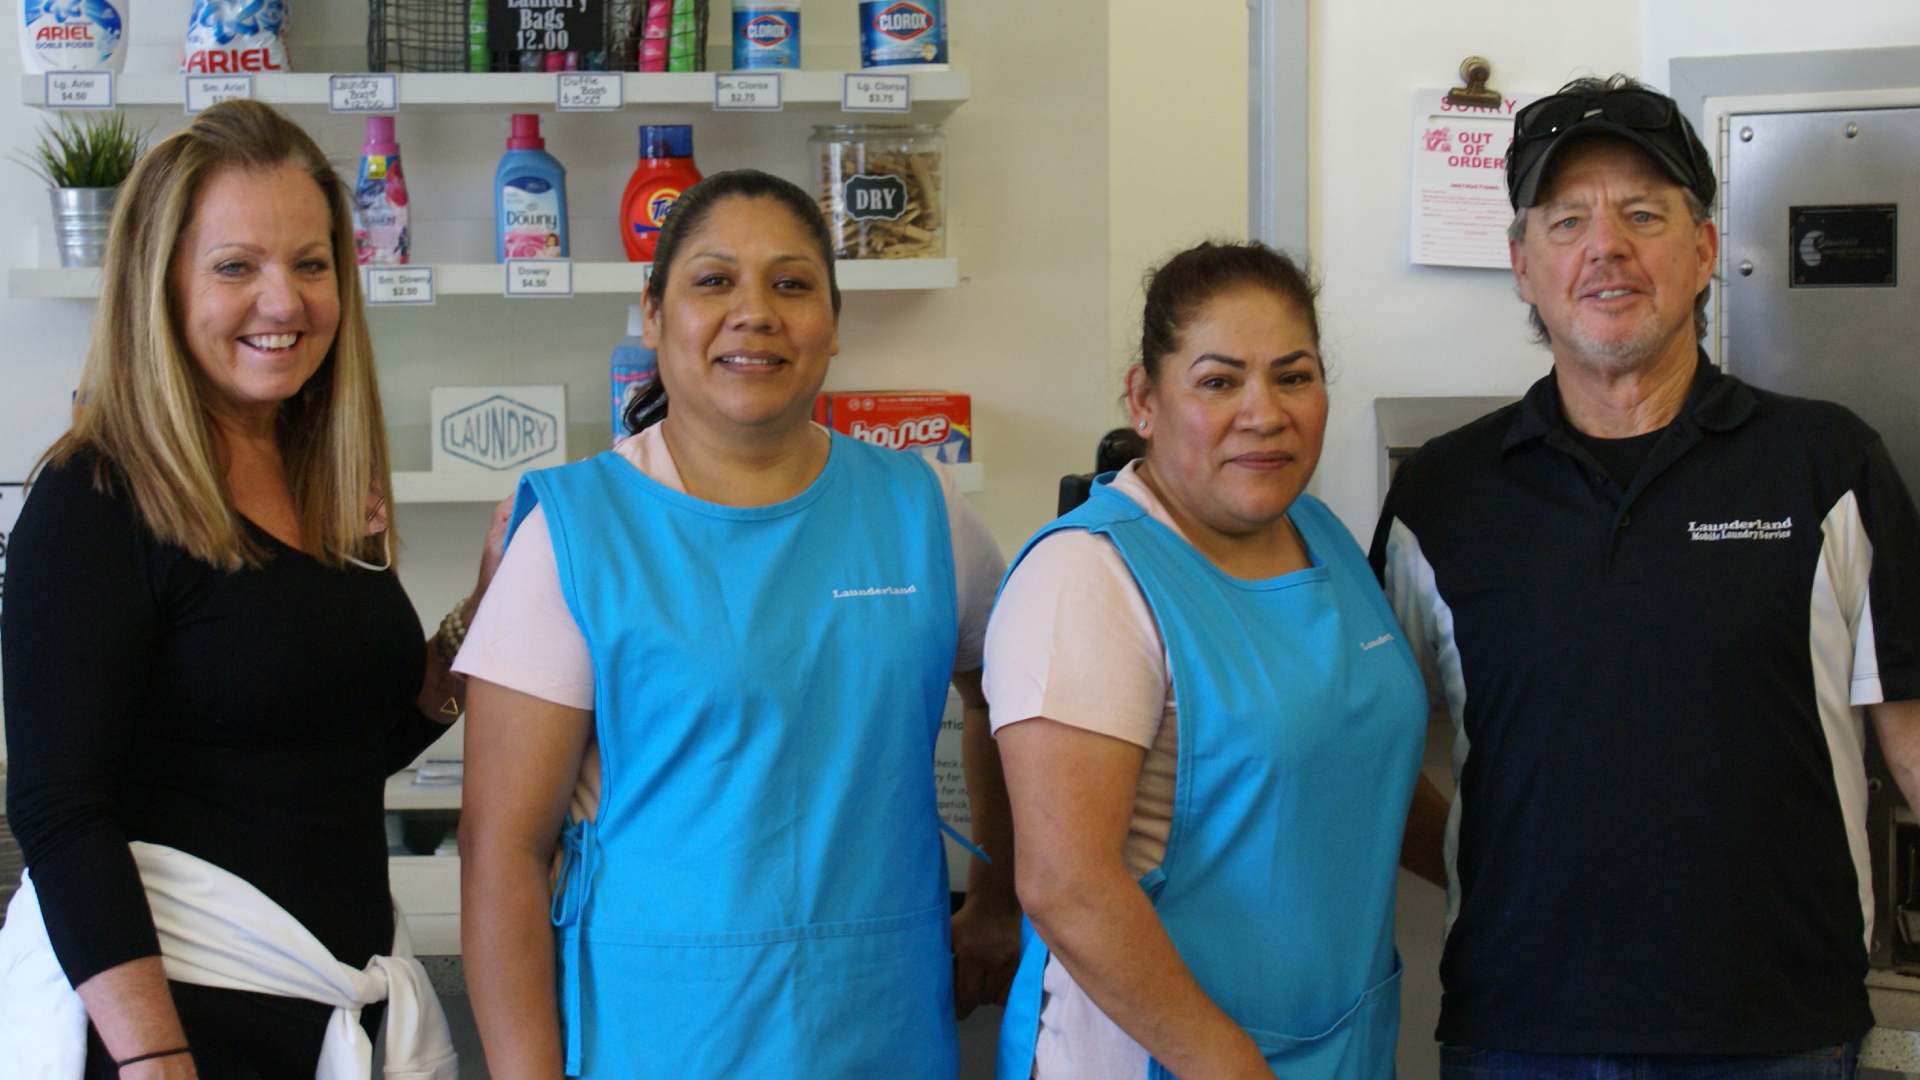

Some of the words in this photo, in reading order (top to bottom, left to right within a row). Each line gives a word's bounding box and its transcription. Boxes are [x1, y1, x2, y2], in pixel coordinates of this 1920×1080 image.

[519, 8, 565, 31] Bags
[879, 12, 927, 31] CLOROX
[36, 26, 95, 41] ARIEL
[746, 25, 787, 38] CLOROX
[516, 29, 569, 50] 12.00
[187, 47, 282, 74] ARIEL
[72, 80, 95, 88] Ariel
[730, 93, 756, 102] $2.75
[1458, 132, 1493, 144] OUT
[1463, 144, 1484, 156] OF
[1448, 155, 1505, 169] ORDER
[855, 188, 897, 210] DRY
[506, 210, 557, 229] Downy
[518, 267, 550, 277] Downy
[450, 406, 548, 462] LAUNDRY
[852, 417, 946, 449] bounce
[1687, 516, 1793, 531] Launderland
[1721, 529, 1758, 540] Laundry
[832, 584, 918, 599] Launderland
